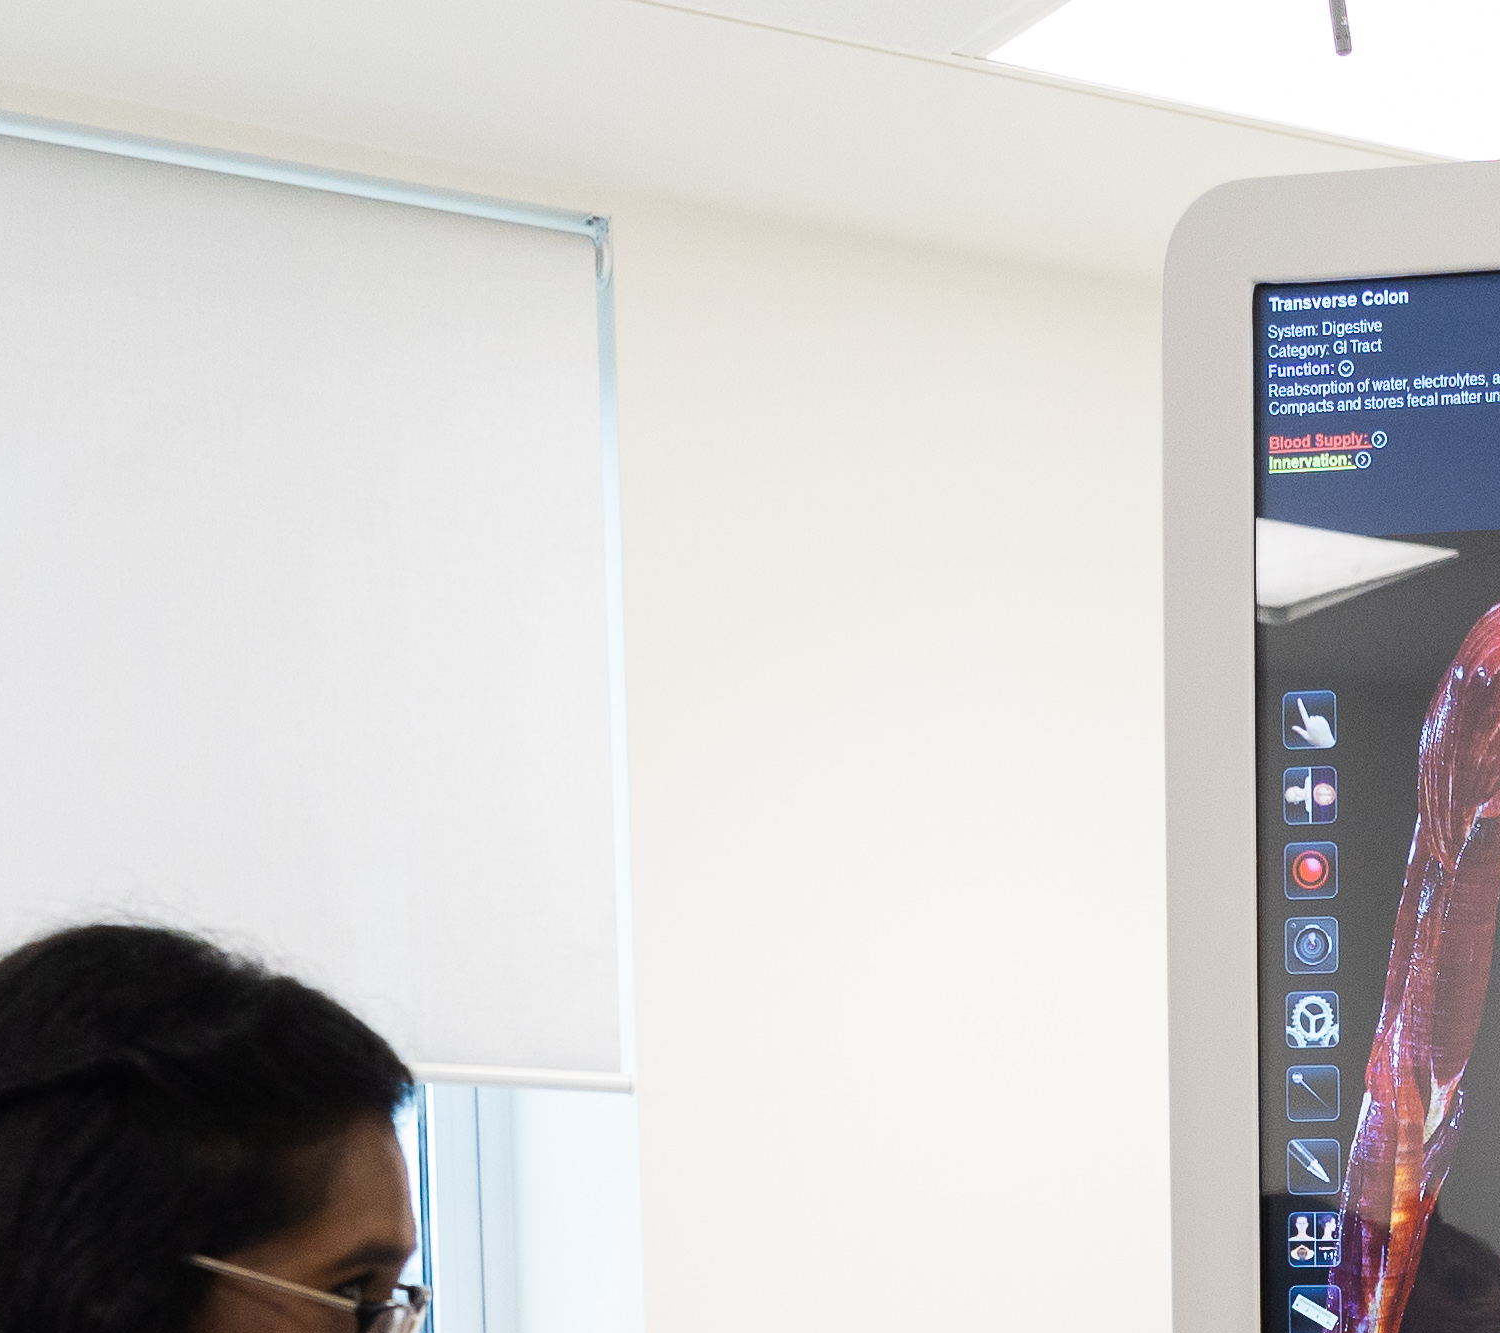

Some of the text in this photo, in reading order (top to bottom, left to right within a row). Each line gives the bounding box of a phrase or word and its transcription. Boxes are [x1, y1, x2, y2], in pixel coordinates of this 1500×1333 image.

[1269, 289, 1409, 312] Transverse Colon
[1267, 319, 1383, 340] System: Digestive
[1267, 338, 1382, 360] Category: GI Tract
[1268, 361, 1335, 379] Function:
[1268, 380, 1354, 398] Reabsorption
[1357, 377, 1370, 393] of
[1372, 377, 1410, 393] water,
[1413, 371, 1488, 390] electrolytes,
[1268, 398, 1334, 417] Compacts
[1337, 395, 1361, 412] and
[1364, 395, 1404, 410] stores
[1406, 391, 1439, 408] fecal
[1441, 390, 1482, 406] matter
[1269, 431, 1369, 451] Blood Supply:
[1269, 453, 1352, 470] Innervation:
